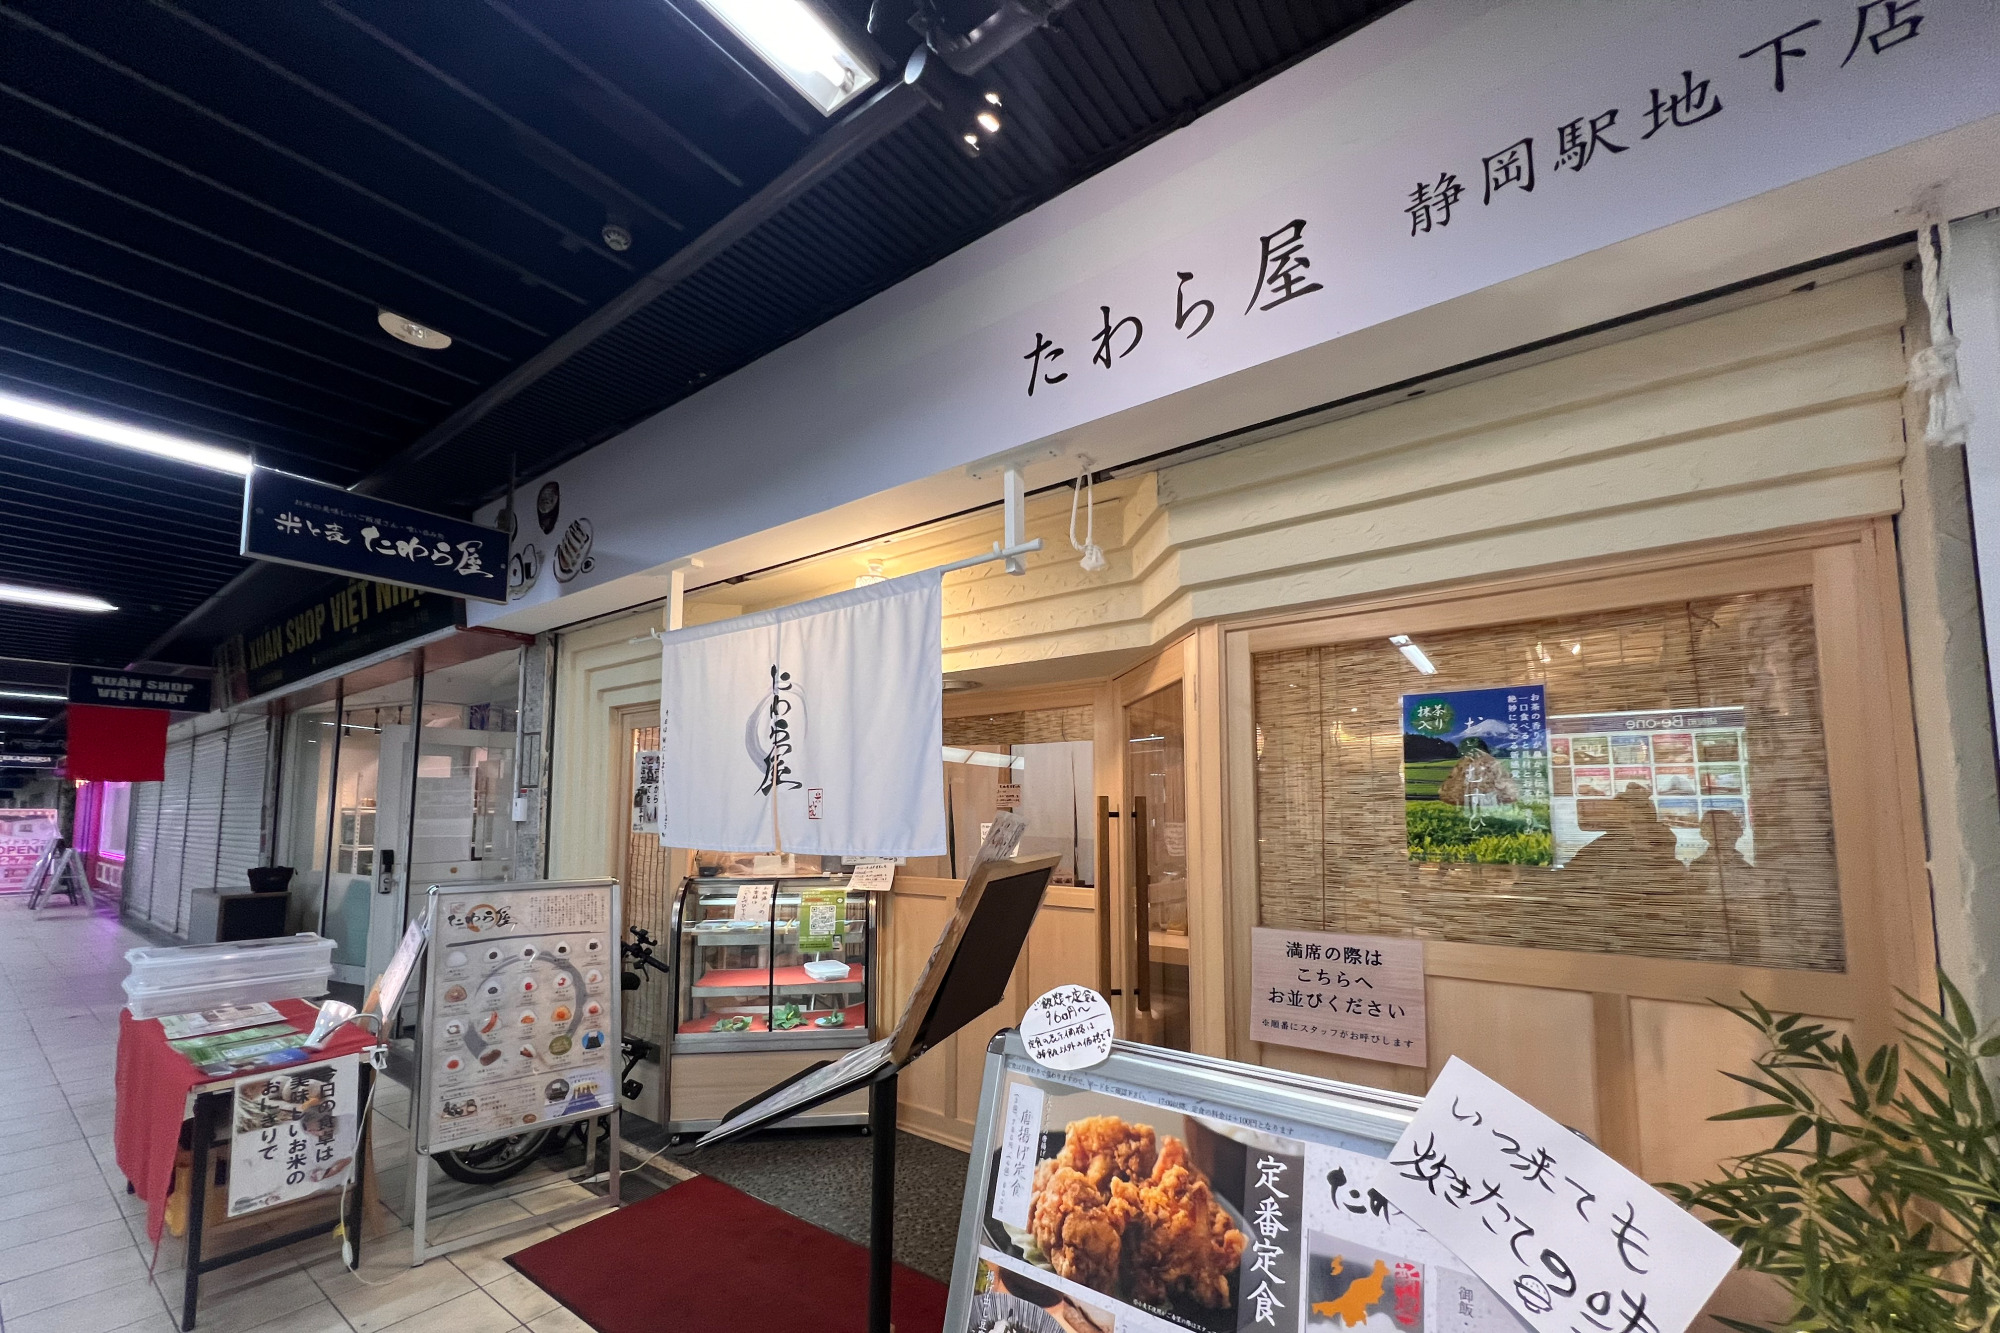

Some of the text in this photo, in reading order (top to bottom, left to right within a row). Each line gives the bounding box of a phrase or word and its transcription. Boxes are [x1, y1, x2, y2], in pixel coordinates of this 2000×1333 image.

[1021, 0, 1924, 396] たわら屋 静岡駅地下店
[274, 511, 494, 579] 米と麦 たわら屋
[286, 603, 326, 652] SHOP
[146, 680, 194, 692] SHOP
[754, 664, 802, 796] たわら屋
[1417, 704, 1446, 718] 抹茶
[1417, 720, 1444, 730] 入り
[447, 904, 518, 928] たわら屋
[1285, 940, 1383, 966] 満席の際は
[1297, 967, 1374, 990] こちらへ
[1268, 986, 1406, 1020] お並びください
[1261, 1018, 1414, 1049] ※順番にスタッフがお呼びします
[259, 1080, 281, 1161] おにぎりで
[1011, 1109, 1032, 1198] 唐揚げ定食
[1452, 1095, 1650, 1275] いつ来ても
[1247, 1154, 1289, 1327] 定番定食
